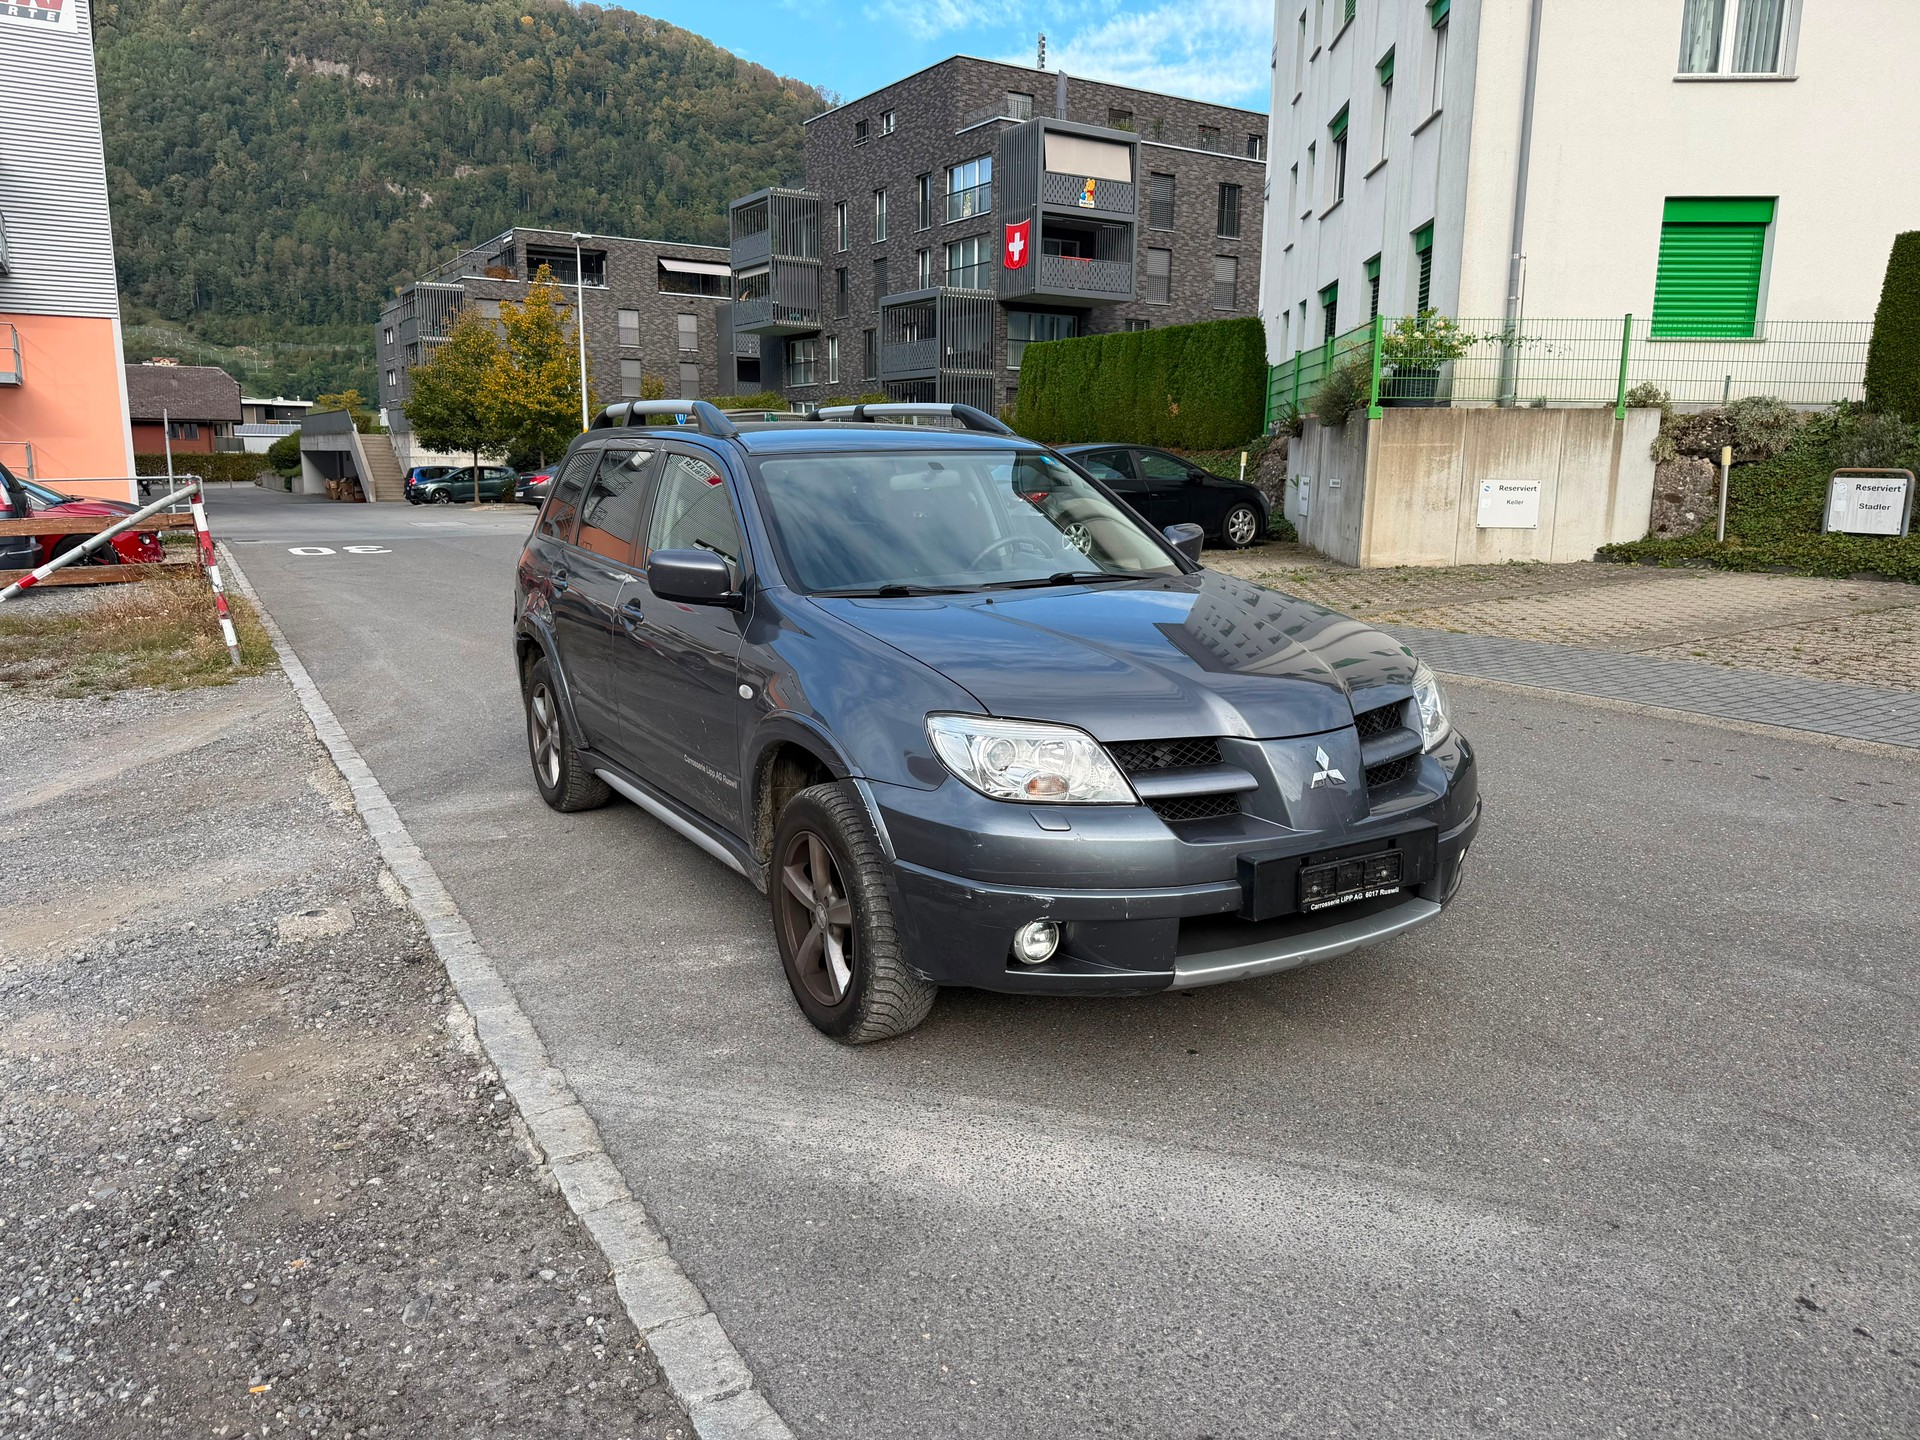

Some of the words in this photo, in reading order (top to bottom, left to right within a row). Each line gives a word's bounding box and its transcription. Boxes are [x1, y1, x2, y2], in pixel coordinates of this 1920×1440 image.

[1498, 484, 1538, 492] Reserviert
[1855, 483, 1902, 493] Reserviert
[1858, 502, 1891, 511] Stadler
[1310, 898, 1340, 911] Carrosserie
[1340, 894, 1354, 903] LIPP
[1353, 892, 1363, 900] AG
[1364, 889, 1379, 898] 6017
